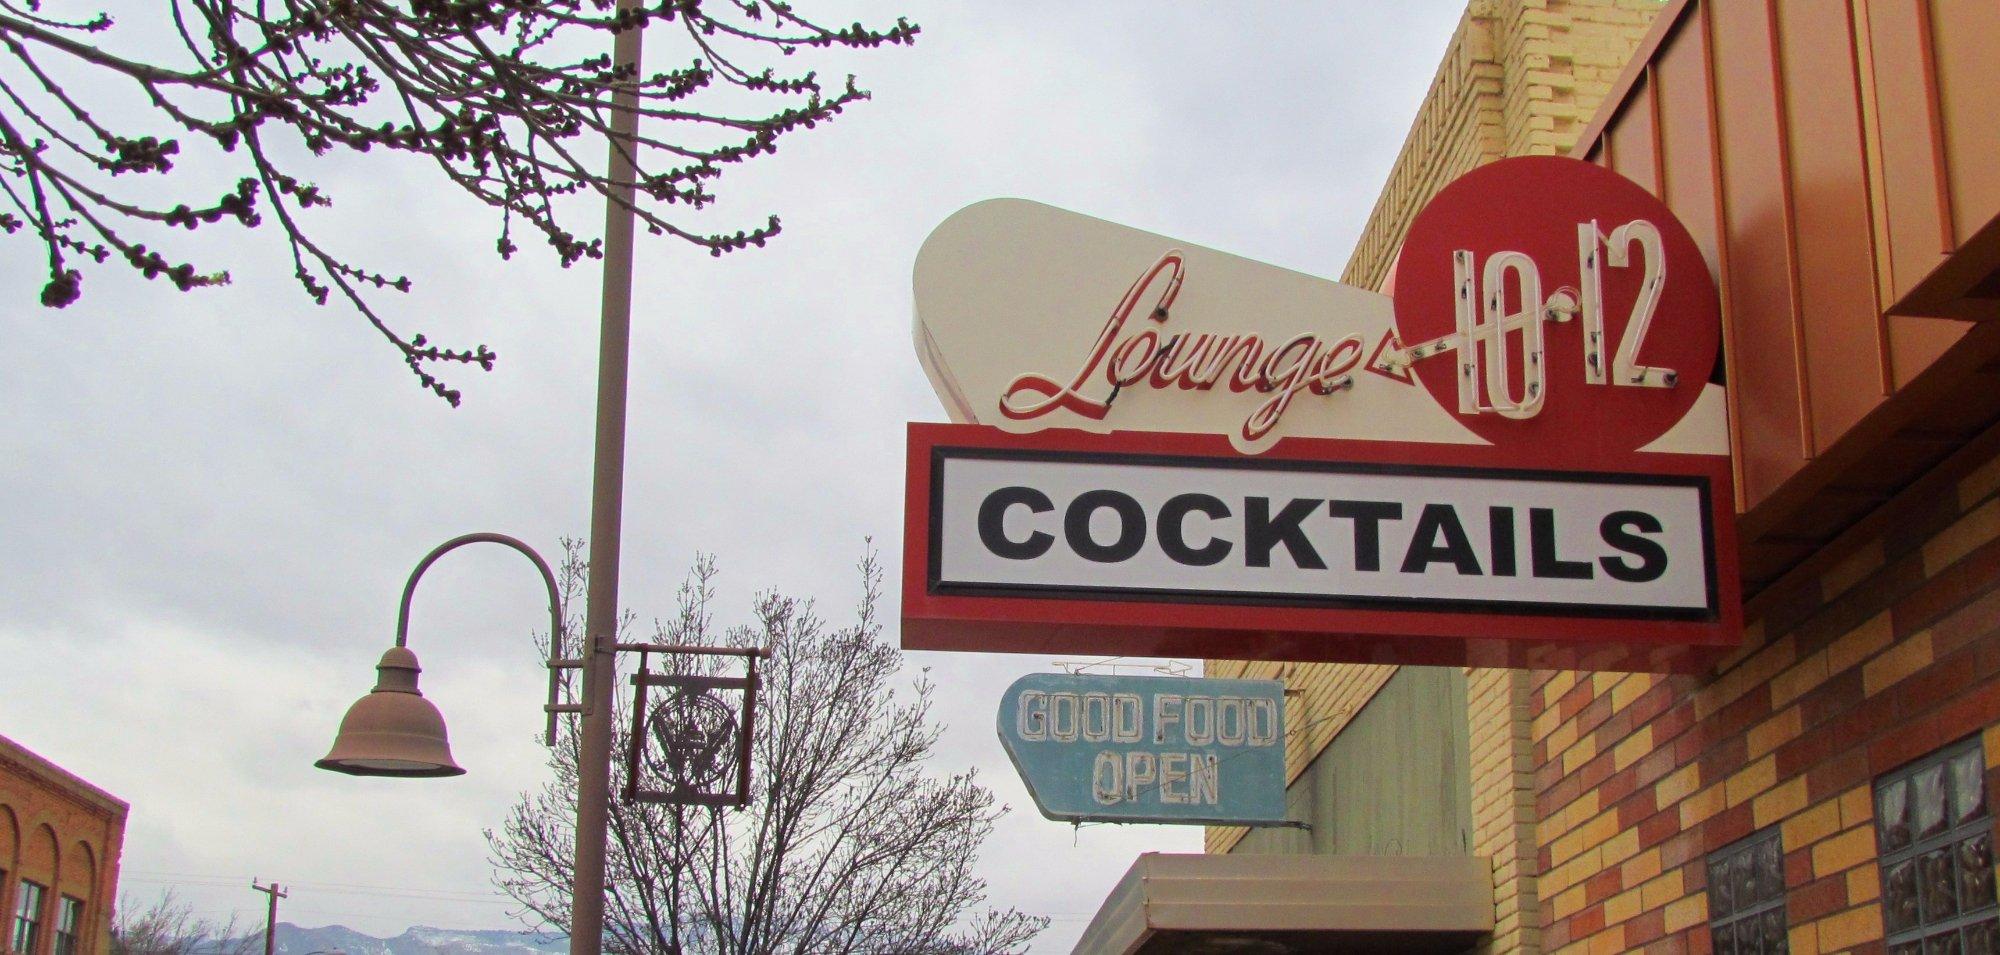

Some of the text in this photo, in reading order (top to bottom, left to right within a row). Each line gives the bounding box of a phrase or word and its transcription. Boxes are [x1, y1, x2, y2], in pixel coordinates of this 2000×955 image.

[999, 248, 1364, 441] Lounge
[977, 486, 1669, 582] COCKTAILS
[1017, 689, 1278, 747] GOOD FOOD
[1092, 750, 1218, 805] OPEN
